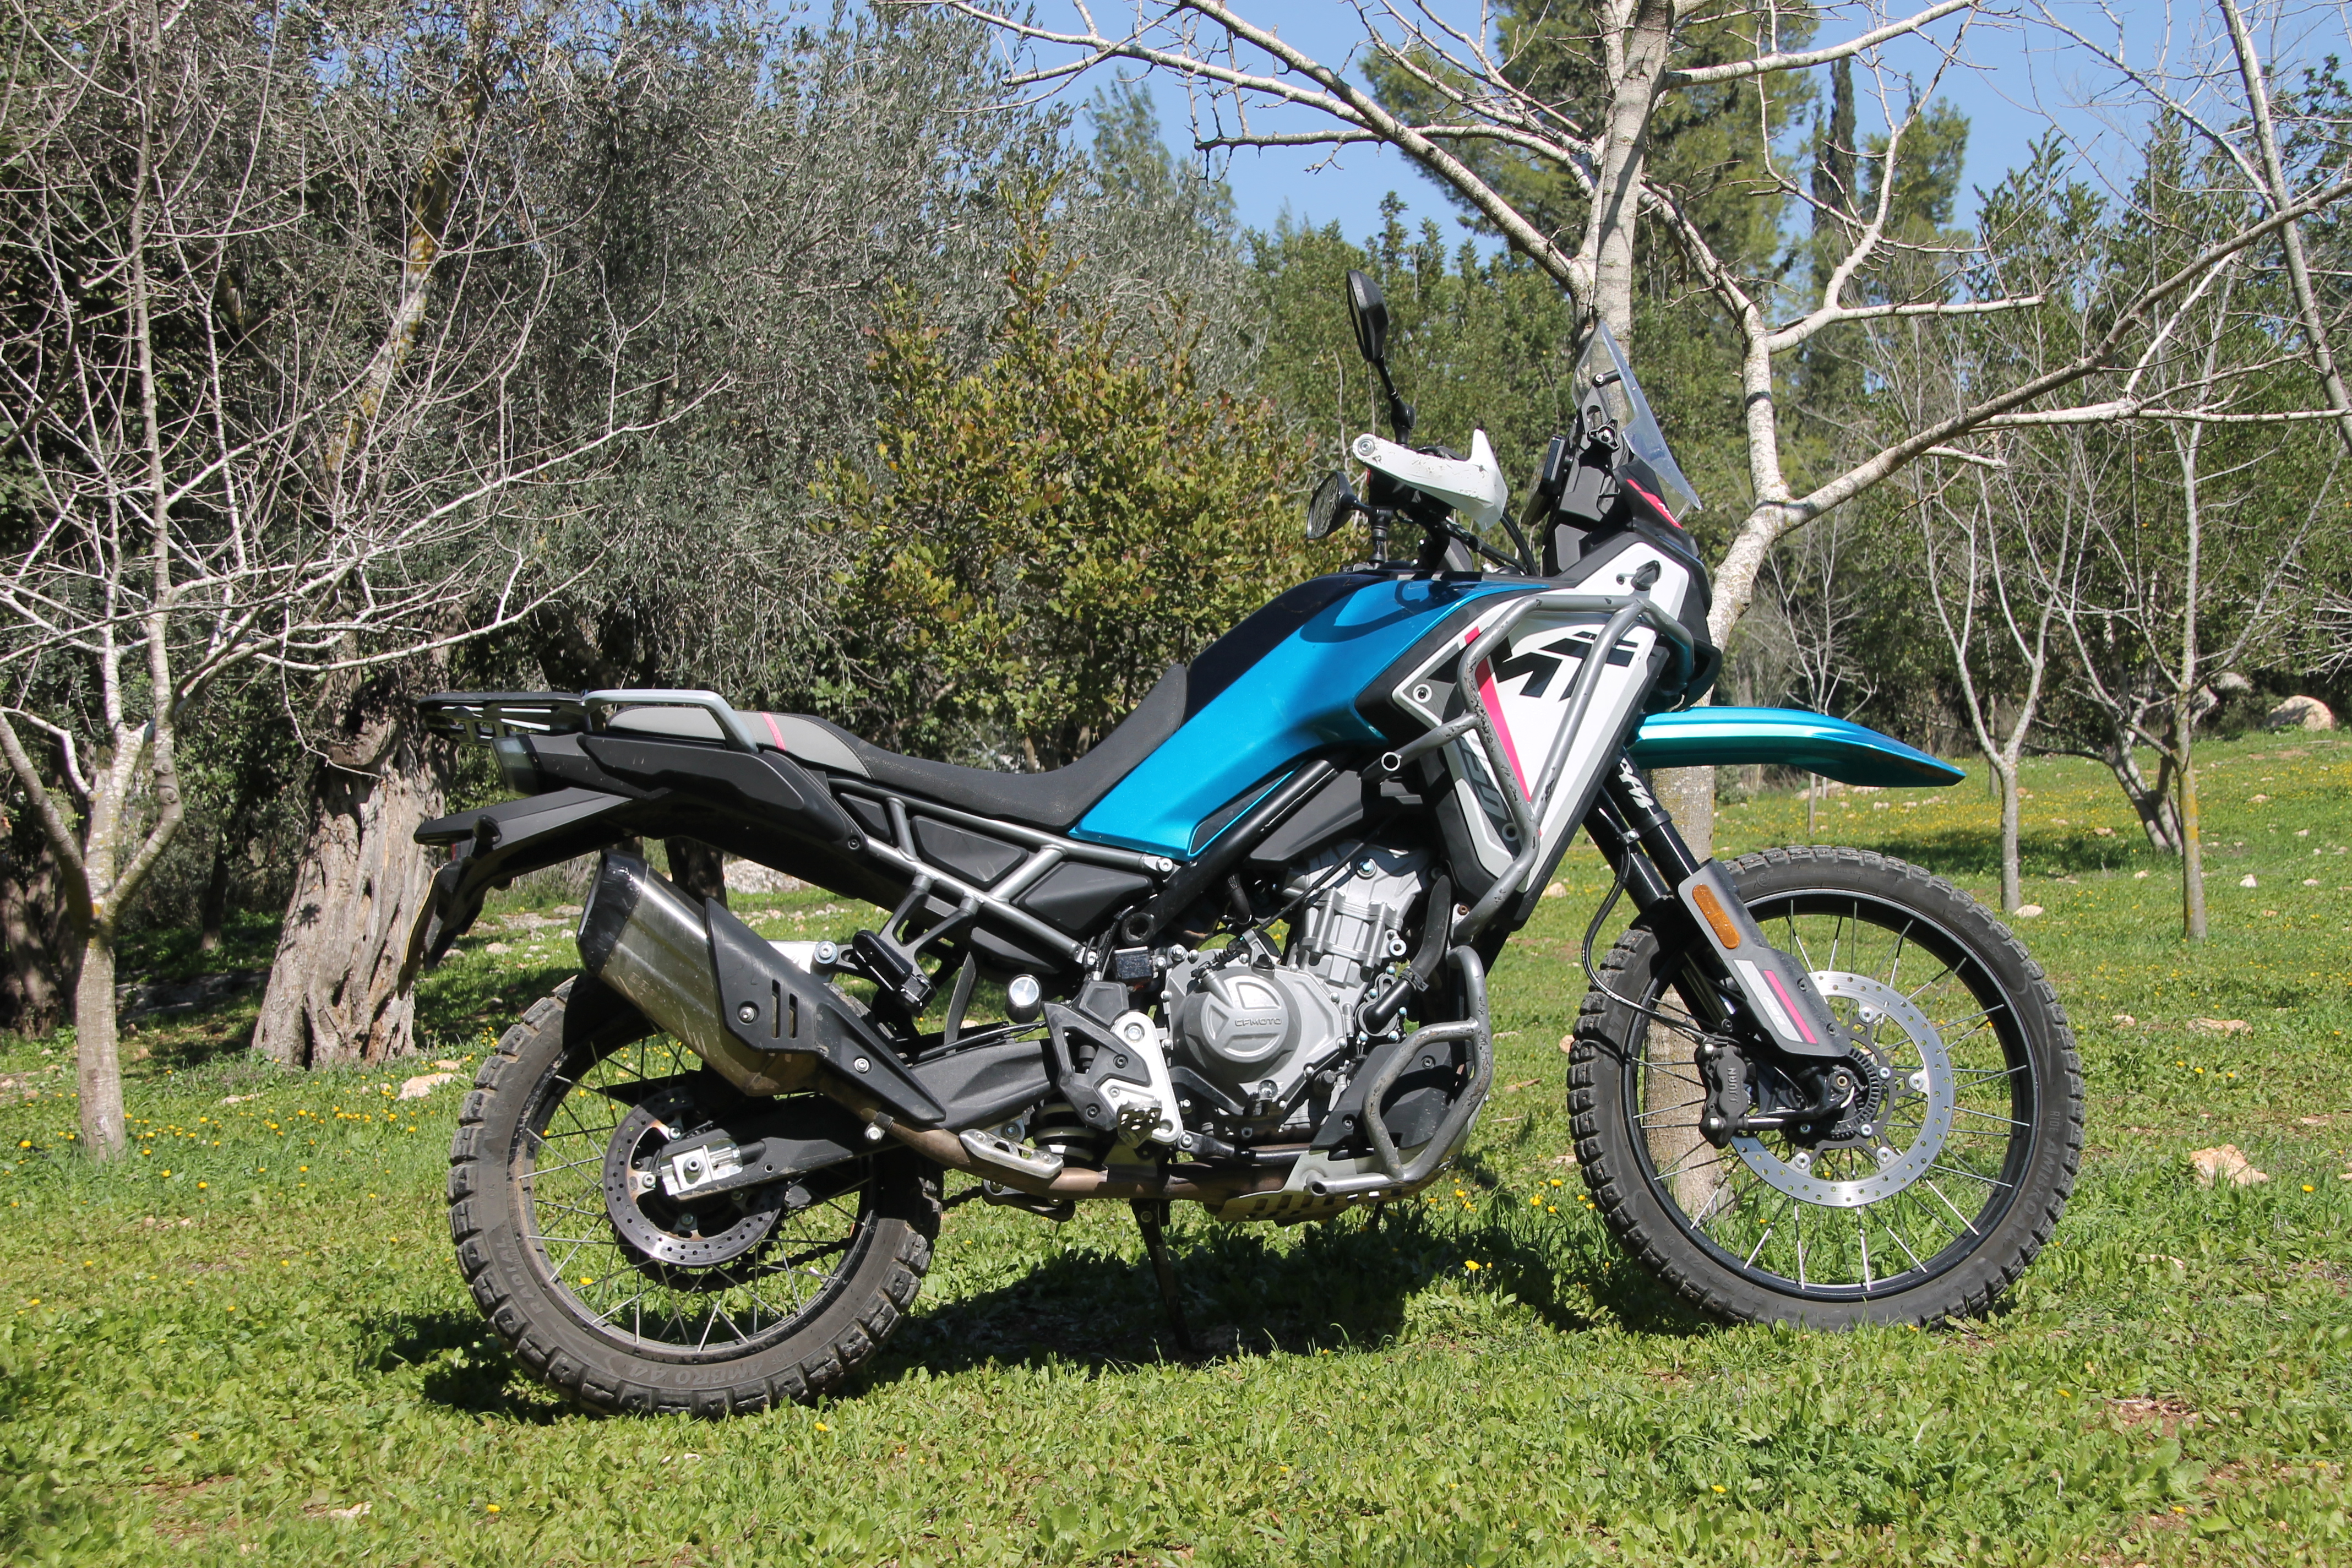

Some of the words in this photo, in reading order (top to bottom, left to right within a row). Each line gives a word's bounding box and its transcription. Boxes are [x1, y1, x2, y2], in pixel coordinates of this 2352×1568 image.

[1235, 1017, 1282, 1027] CFMOTO
[2049, 1111, 2060, 1133] RIDE
[2023, 1137, 2059, 1216] AMBRO
[496, 1238, 545, 1314] RADIAL
[629, 1361, 668, 1384] A4
[675, 1358, 764, 1386] AMBRO
